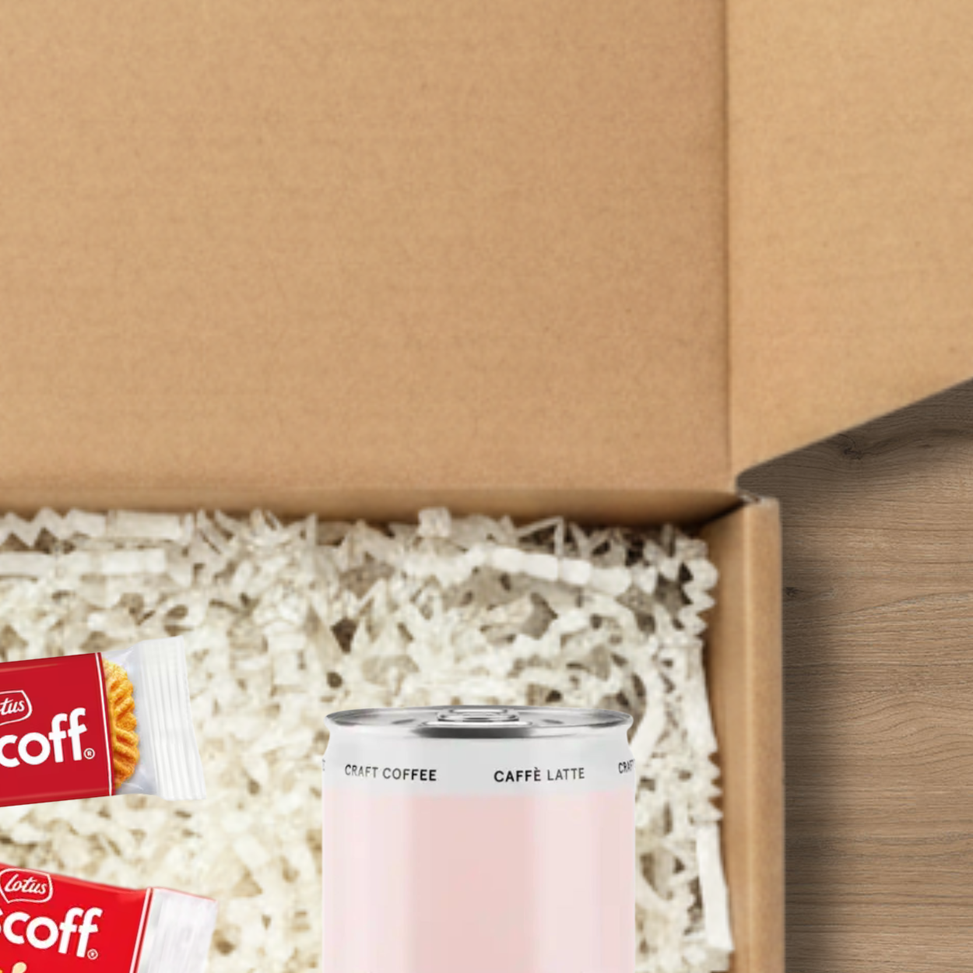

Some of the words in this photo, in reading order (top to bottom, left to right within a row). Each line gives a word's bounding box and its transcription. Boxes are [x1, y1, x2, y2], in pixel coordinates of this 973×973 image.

[344, 764, 379, 777] CRAFT
[382, 768, 437, 781] COFFEE
[494, 767, 541, 782] CAFFÈ
[547, 768, 585, 781] LATTE
[5, 874, 47, 895] Lotus
